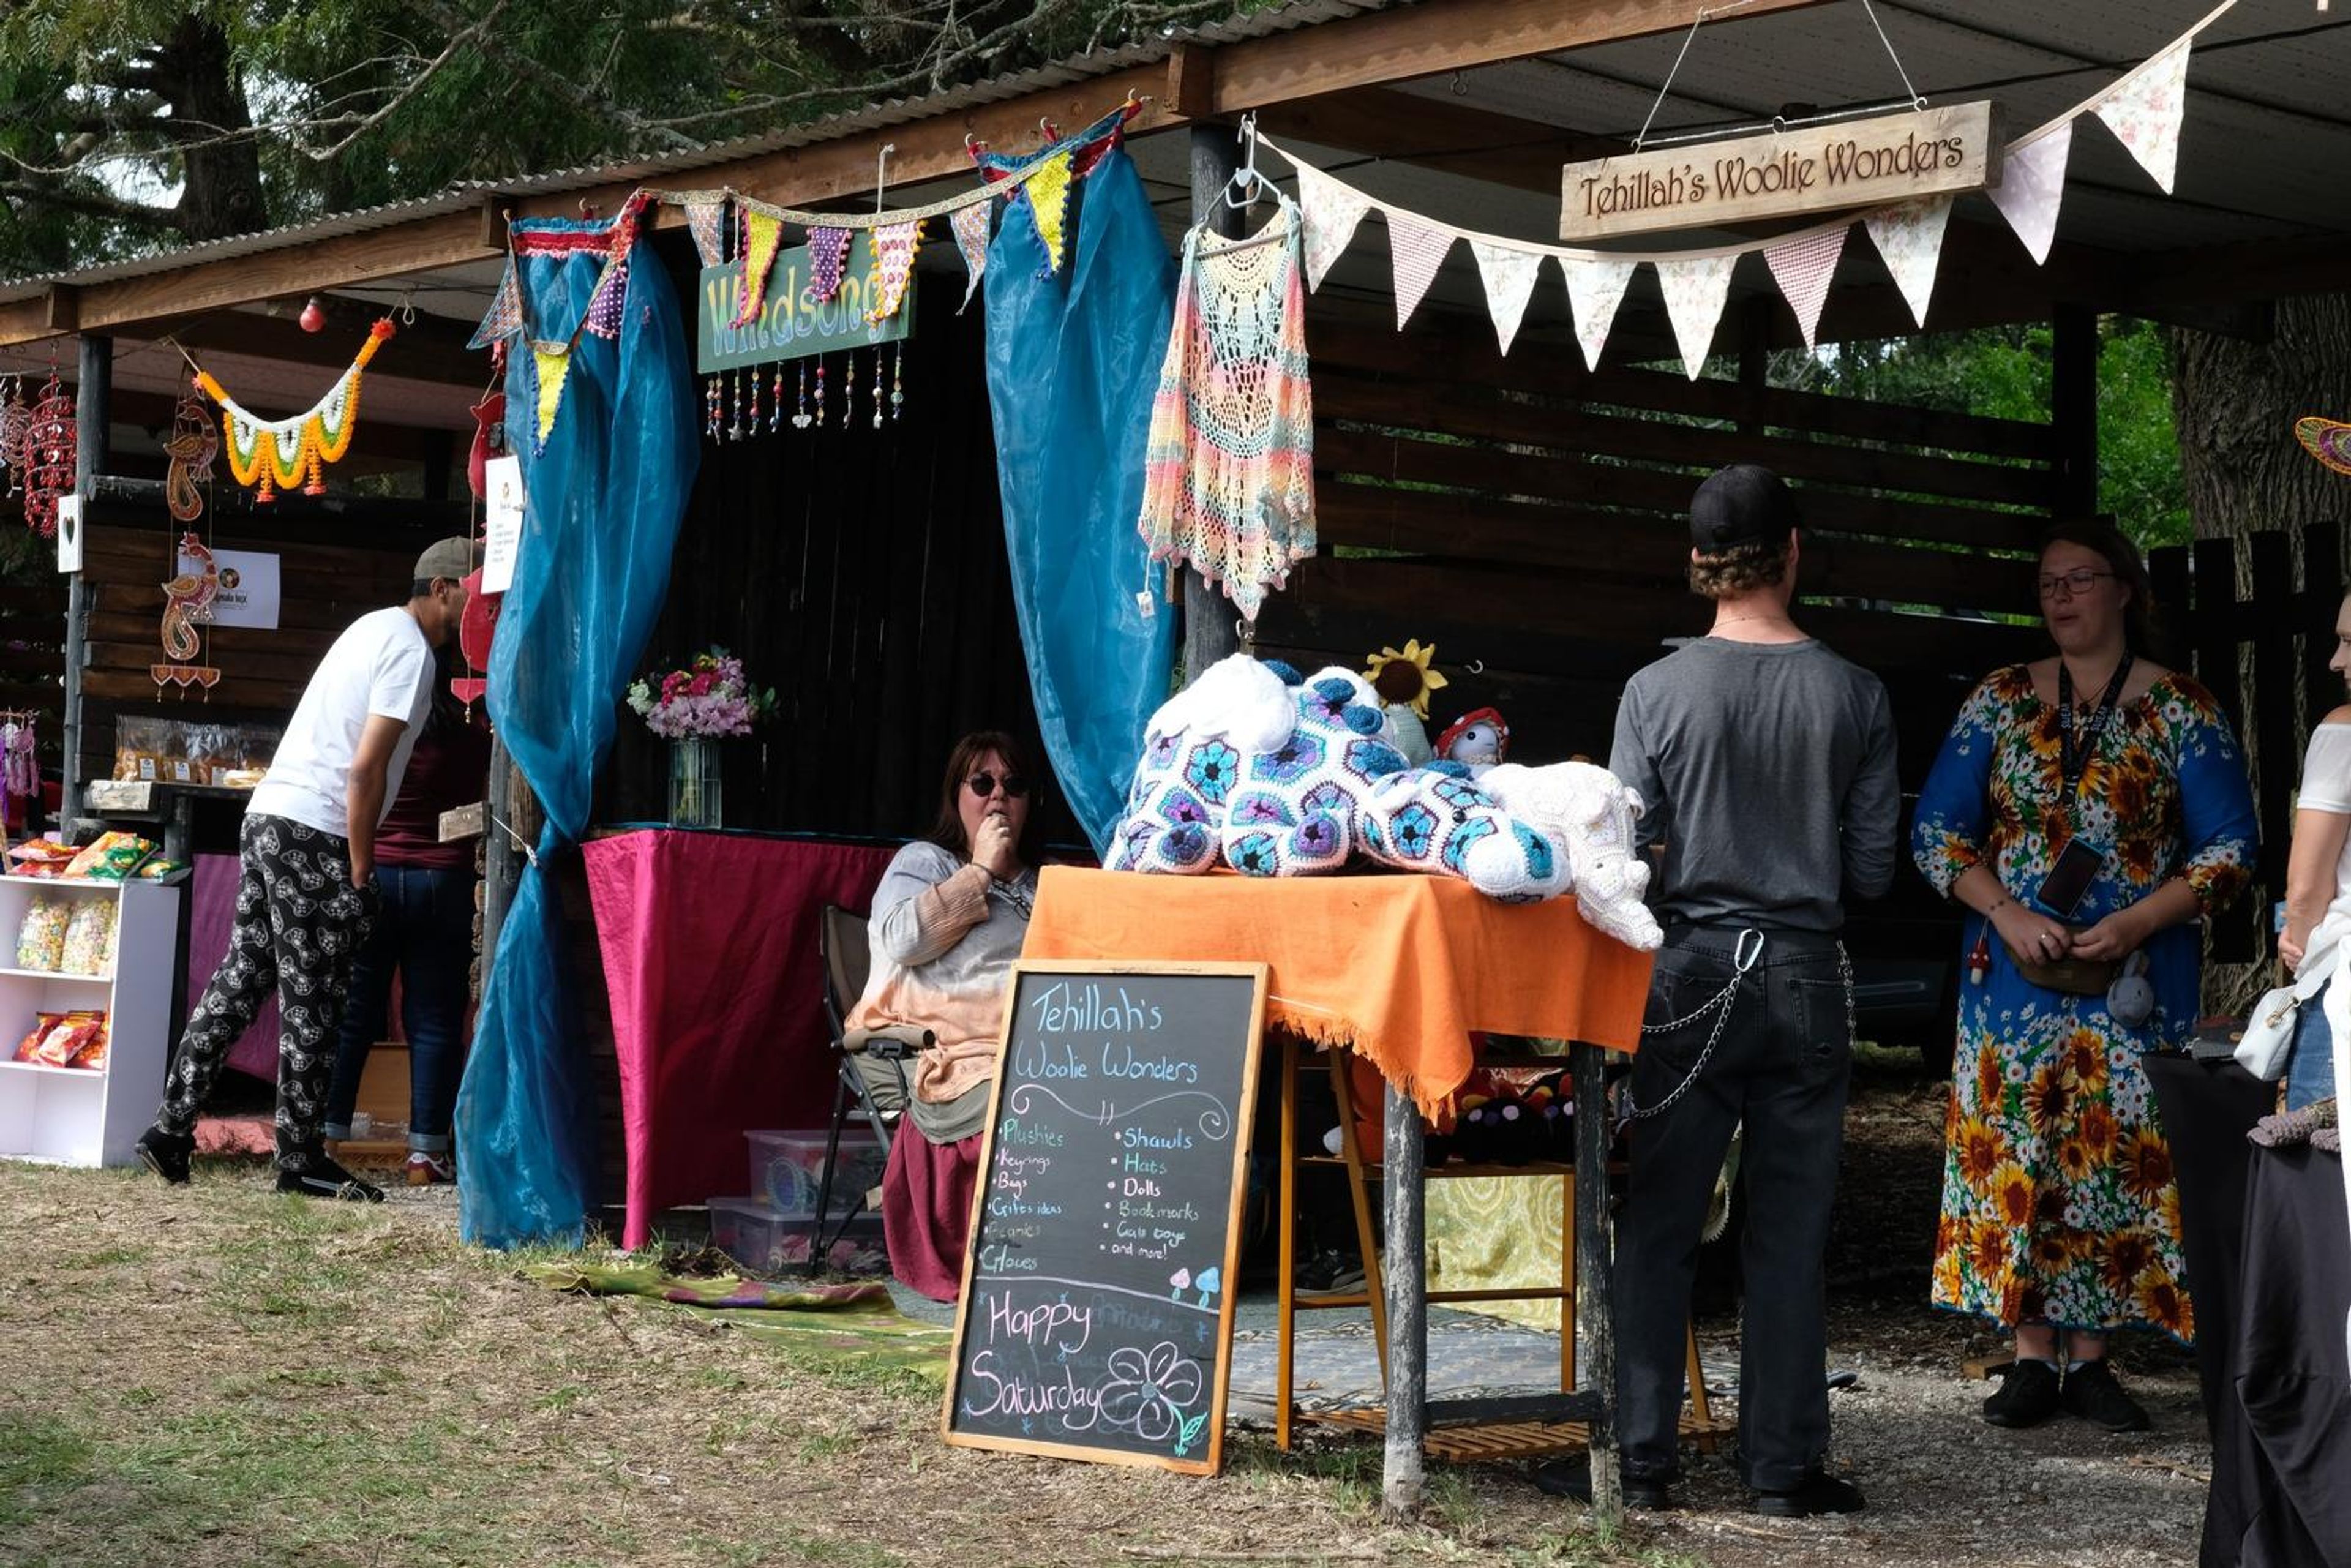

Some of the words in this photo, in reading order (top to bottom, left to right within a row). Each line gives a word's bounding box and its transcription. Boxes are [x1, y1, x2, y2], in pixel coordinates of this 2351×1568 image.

[1581, 163, 1705, 220] Tehillah's
[1714, 150, 1816, 200] Woolie
[1825, 131, 1963, 185] Wonders
[1032, 982, 1163, 1033] Tehillah's
[1015, 1040, 1089, 1079] Woolie
[1102, 1041, 1198, 1084] Wonders
[1003, 1118, 1064, 1147] Plushies
[1123, 1127, 1193, 1149] Shawls
[1000, 1148, 1051, 1175] Keyrings
[1124, 1152, 1168, 1175] Hats
[998, 1171, 1029, 1201] Bags
[1124, 1177, 1162, 1198] Dolls
[1119, 1200, 1199, 1222] Bookmarks
[981, 1244, 1038, 1274] Gloves
[1112, 1242, 1134, 1256] and
[989, 1290, 1092, 1353] Happy
[967, 1350, 1101, 1431] Saturday
